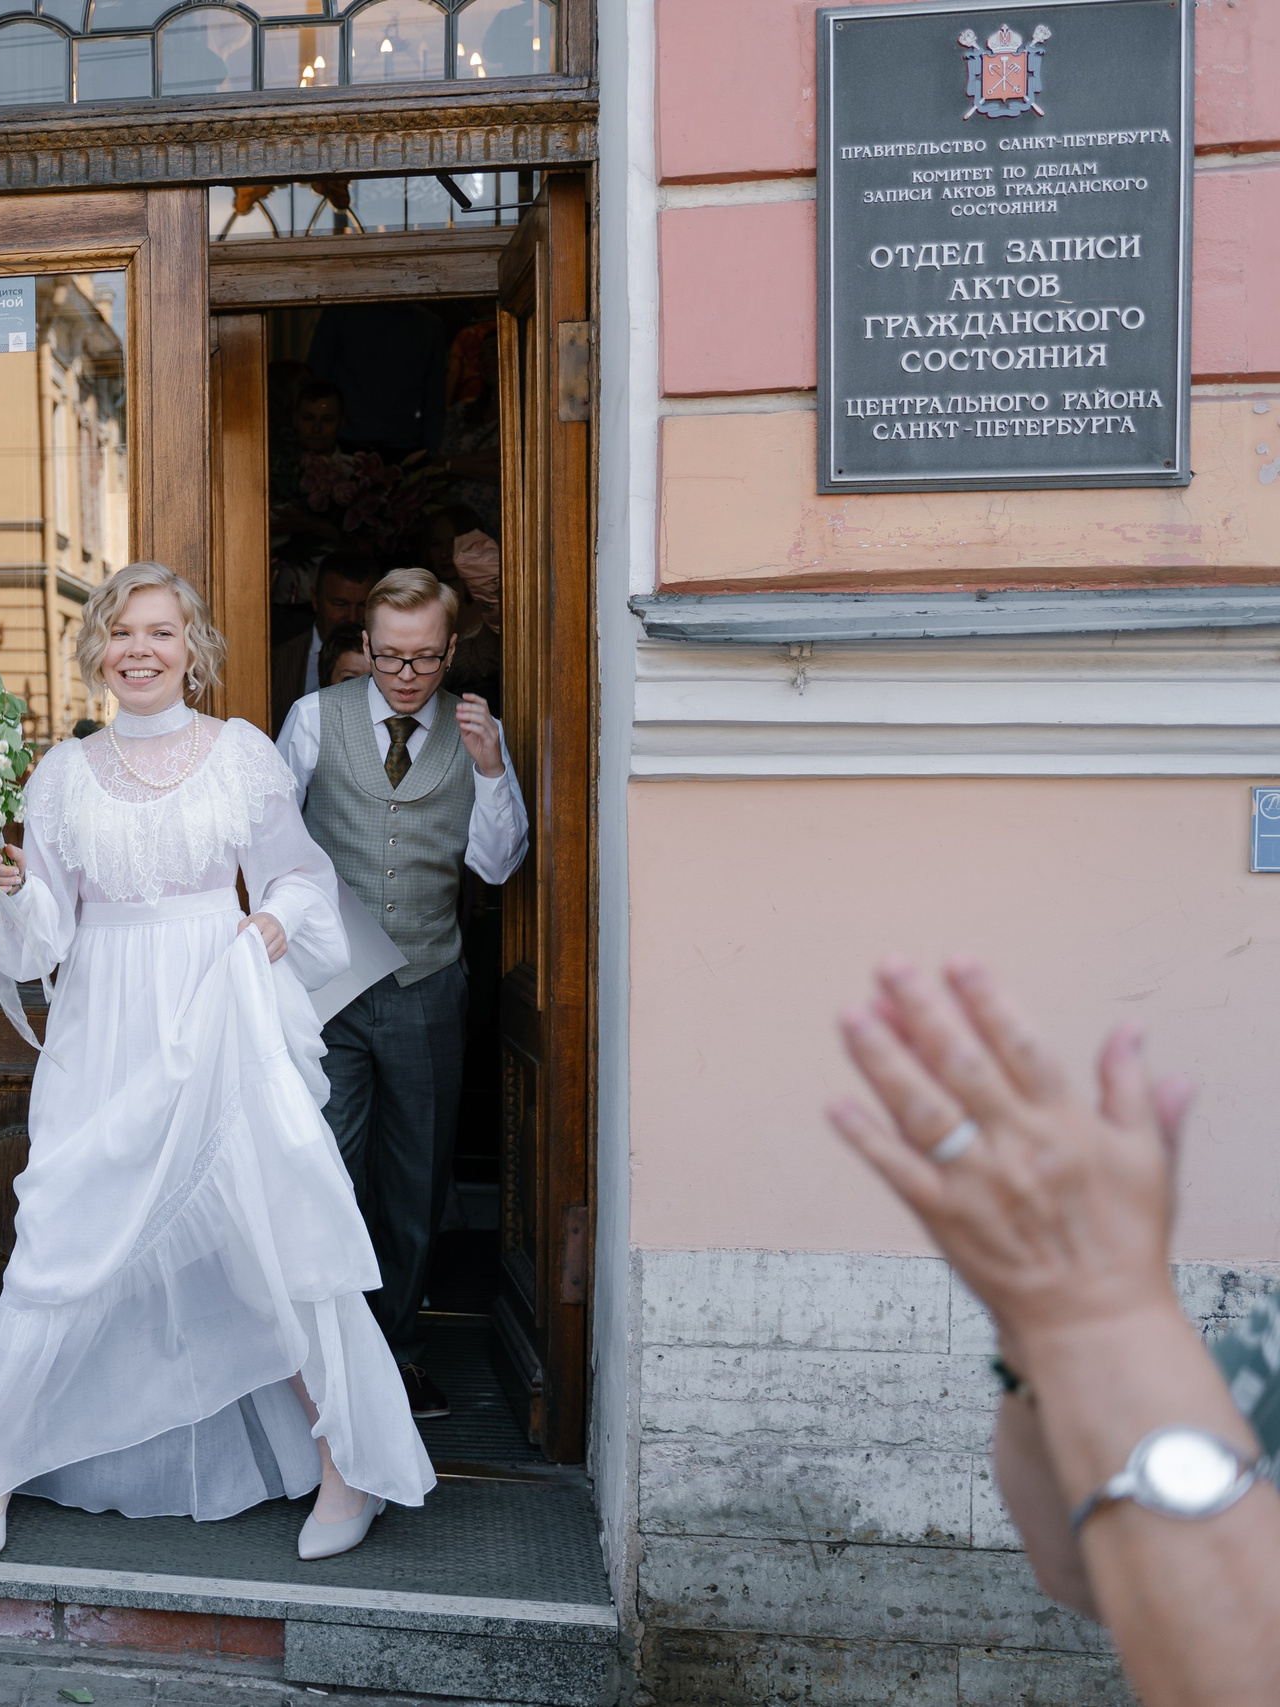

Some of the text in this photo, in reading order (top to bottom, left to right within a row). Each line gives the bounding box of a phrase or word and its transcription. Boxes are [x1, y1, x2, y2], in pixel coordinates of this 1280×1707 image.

[841, 129, 1171, 160] ПРАВИТЕЛЬСТВО САНКТ-ПЕТЕРБУРГА
[912, 163, 1098, 184] КОМИТЕТ ПО ДЕЛАМ
[864, 178, 1148, 203] ЗАПИСИ АКТОВ ГРАЖДАНСКОГО
[951, 201, 1058, 217] СОСТОЯНИЯ
[870, 235, 1141, 271] ОТДЕЛ ЗАПИСИ
[949, 274, 1060, 301] АКТОВ
[864, 307, 1145, 340] ГРАЖДАНСКОГО
[901, 344, 1107, 372] СОСТОЯНИЯ
[846, 389, 1163, 419] ЦЕНТРАЛЬНОГО РАЙОНА
